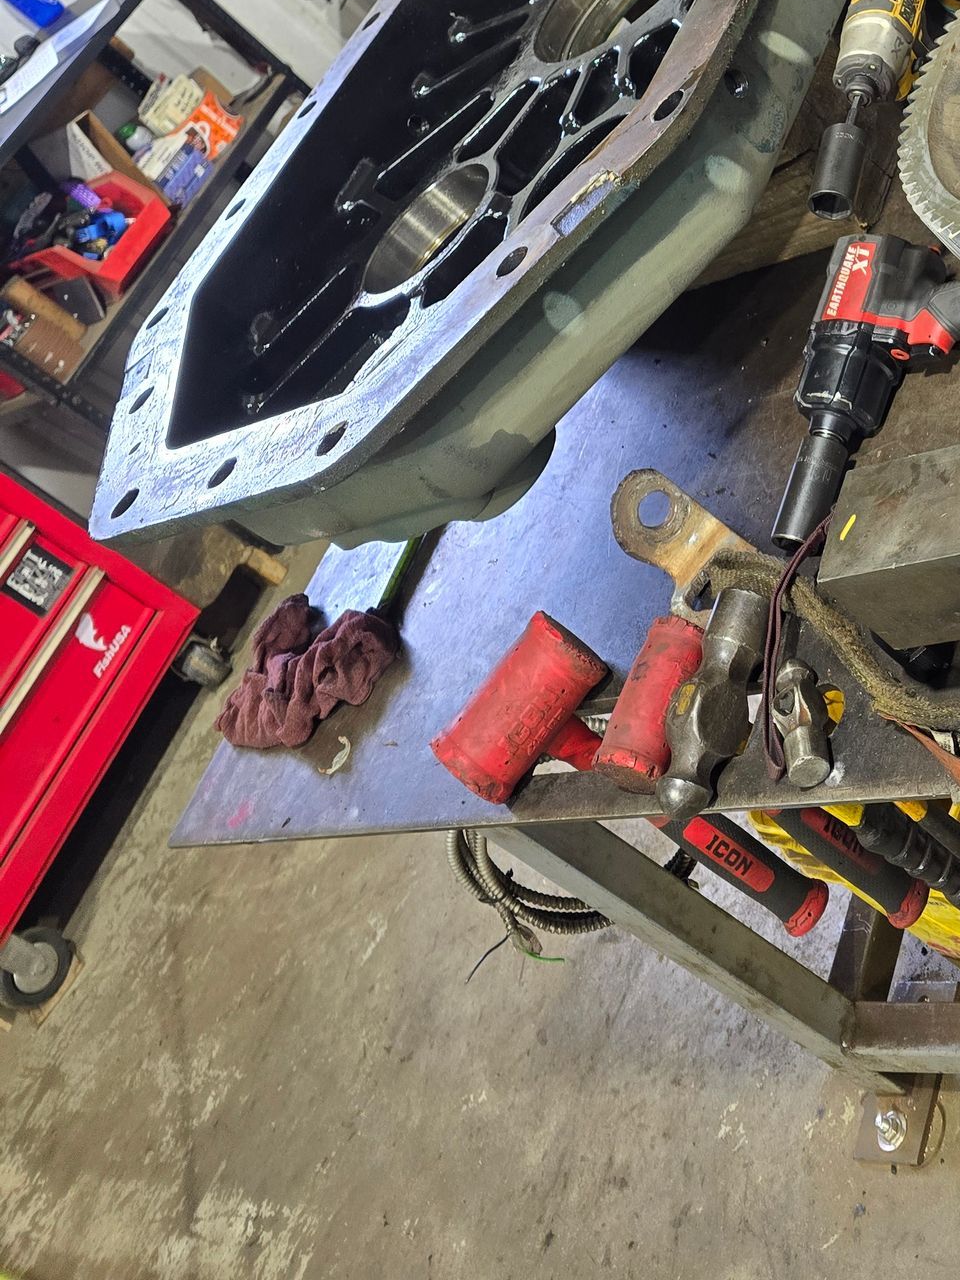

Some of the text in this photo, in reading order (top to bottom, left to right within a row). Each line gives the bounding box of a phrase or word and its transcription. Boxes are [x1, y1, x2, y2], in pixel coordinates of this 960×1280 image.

[826, 245, 856, 316] EARTHQUAKE
[852, 245, 869, 275] XT
[92, 624, 132, 678] FishUSA
[705, 834, 753, 875] ICON
